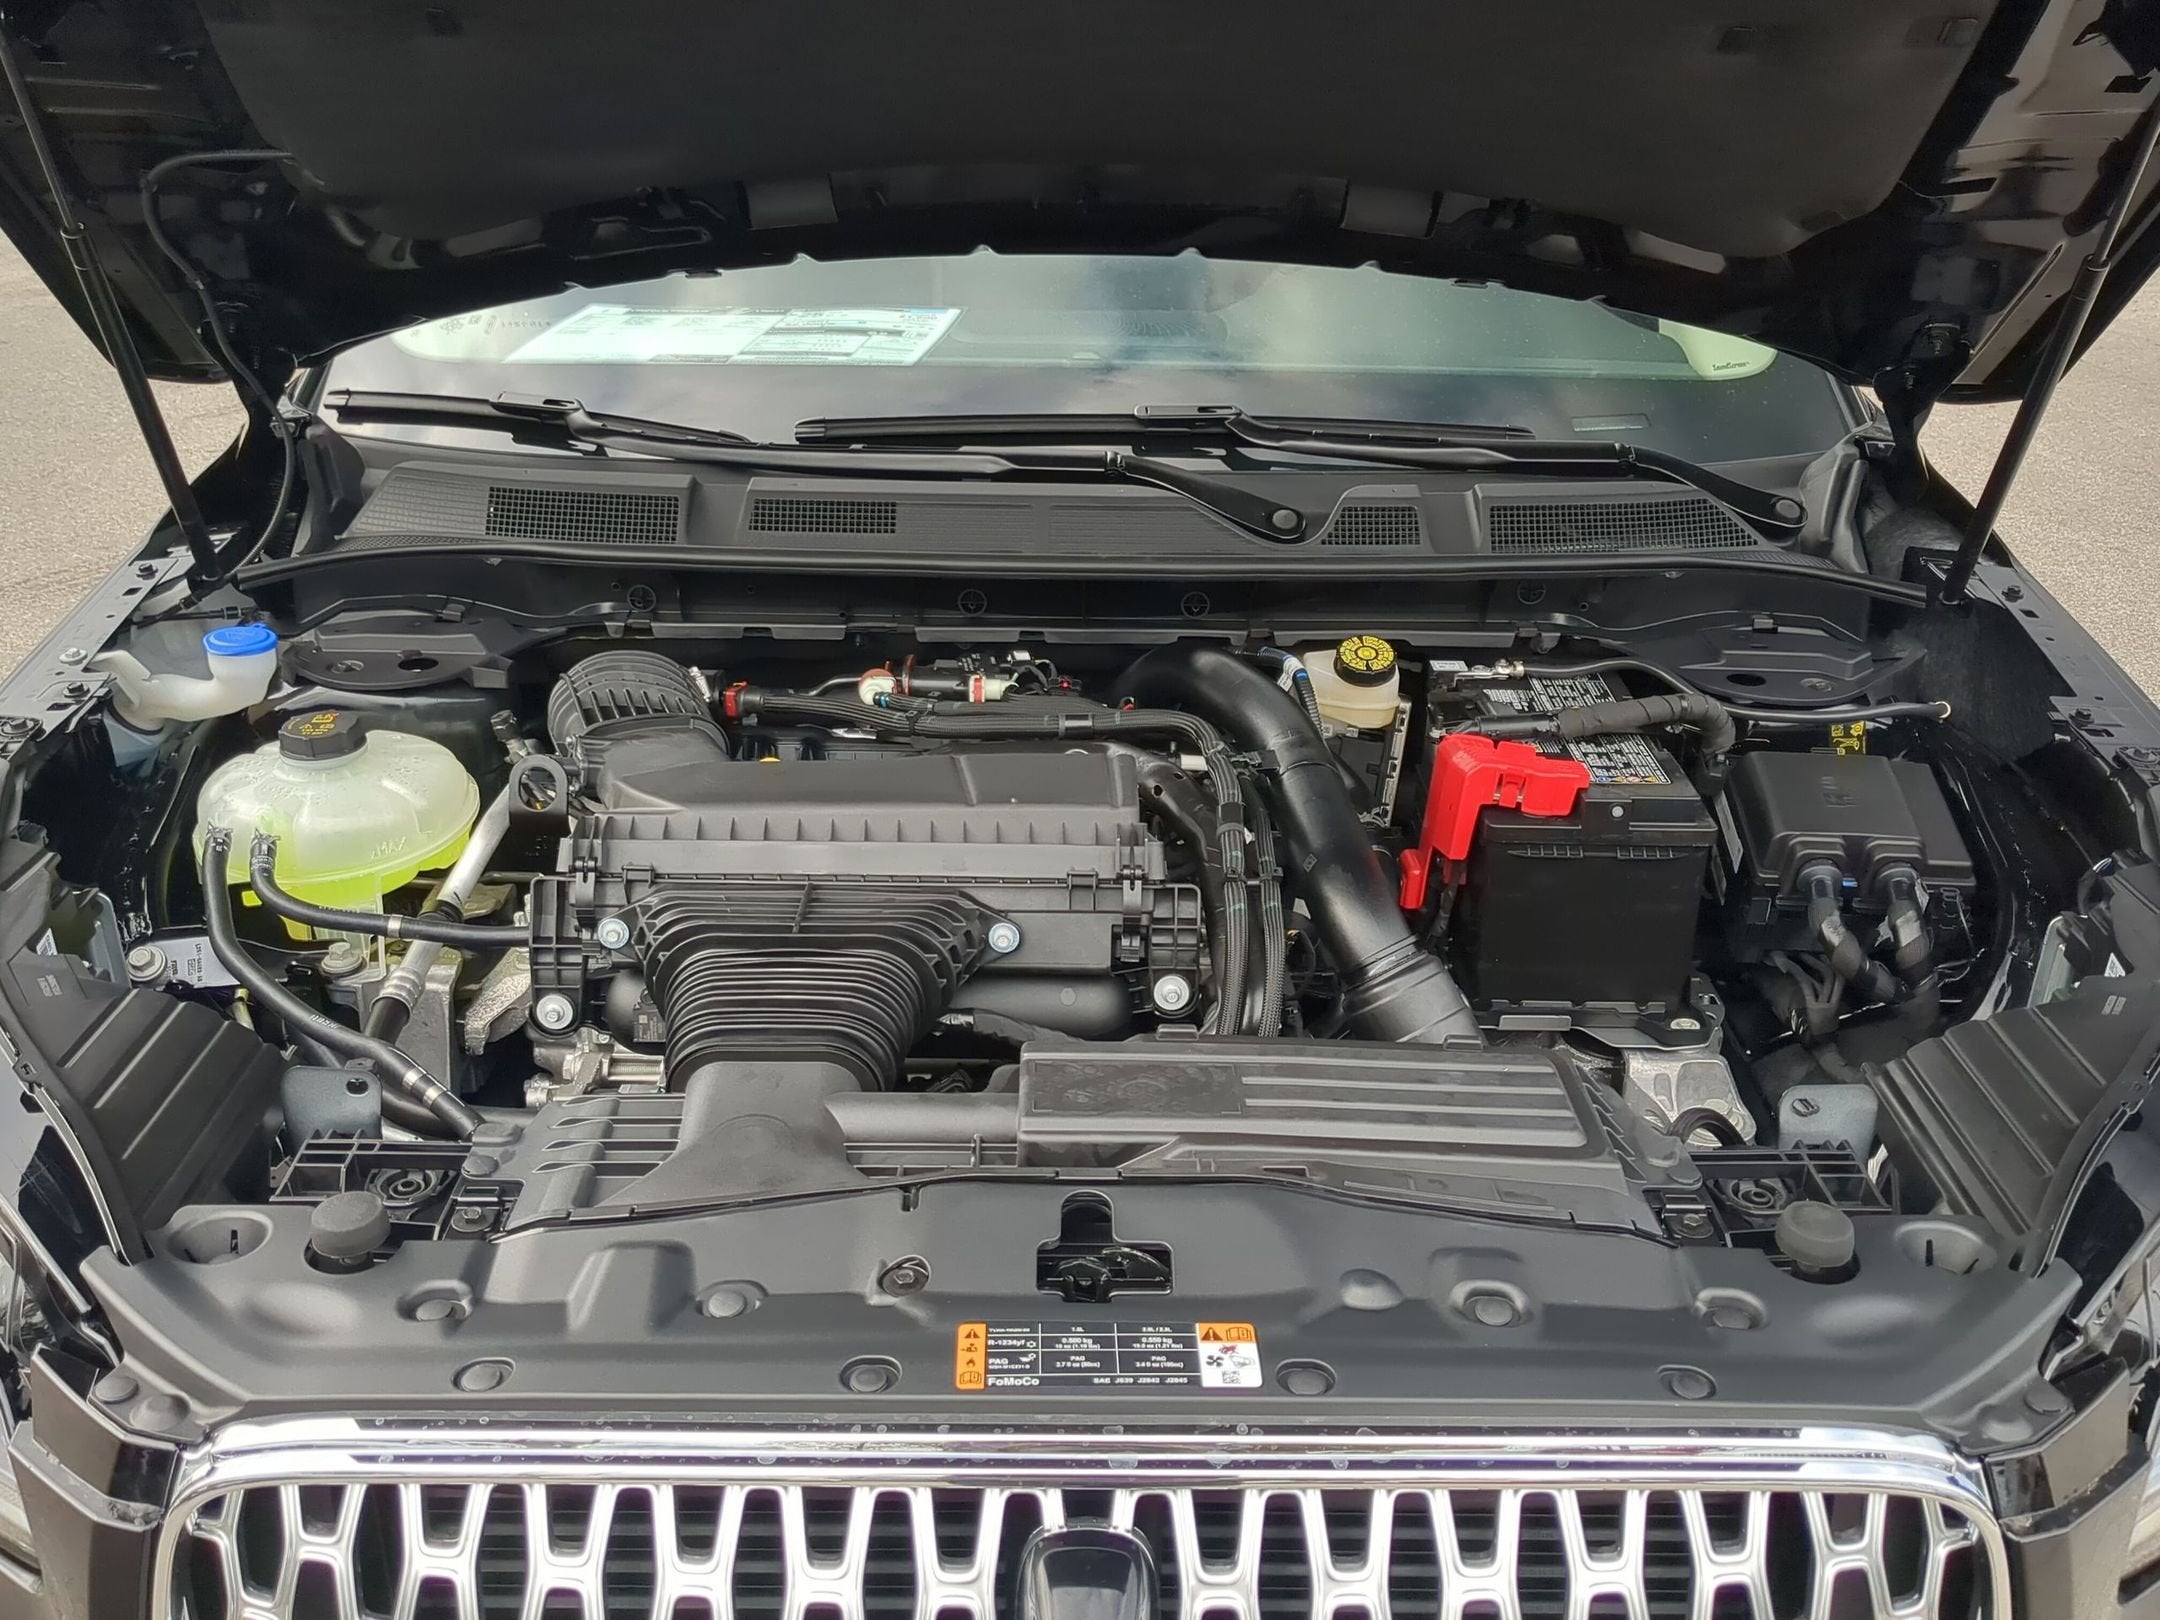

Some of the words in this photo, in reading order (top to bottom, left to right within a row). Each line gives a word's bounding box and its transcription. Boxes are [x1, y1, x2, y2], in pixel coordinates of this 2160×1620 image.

[987, 1339, 1026, 1347] R-1234yf
[1082, 1337, 1093, 1345] kg
[1162, 1336, 1172, 1344] kg
[987, 1376, 1040, 1386] FoMoCo
